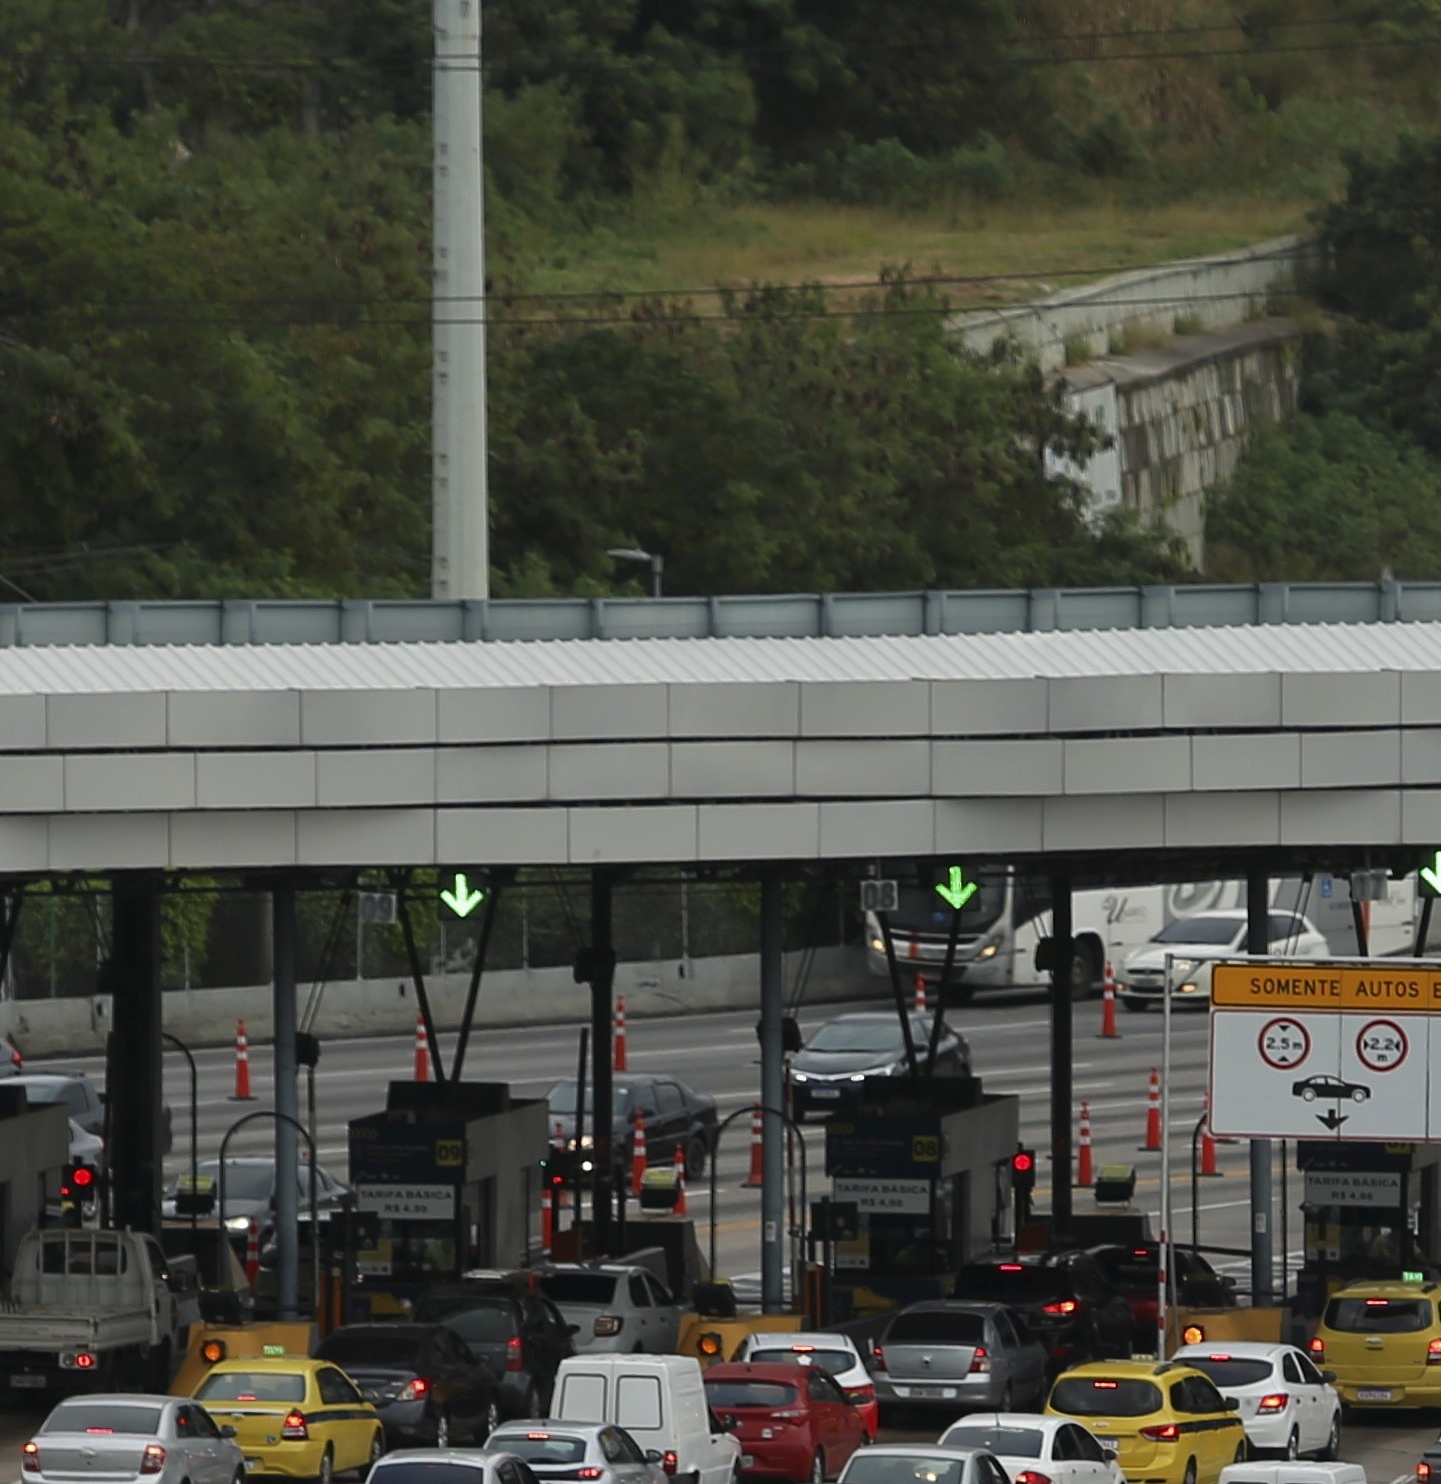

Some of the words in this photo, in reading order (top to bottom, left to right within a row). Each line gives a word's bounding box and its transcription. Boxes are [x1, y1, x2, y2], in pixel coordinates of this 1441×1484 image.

[864, 882, 894, 910] 08
[361, 895, 392, 922] 09
[1250, 977, 1341, 997] SOMENTE
[1356, 981, 1419, 998] AUTOS
[1293, 1042, 1303, 1050] m
[1377, 1053, 1388, 1062] m
[439, 1145, 460, 1161] 09
[915, 1141, 936, 1156] 08
[1403, 1271, 1423, 1283] TAXI
